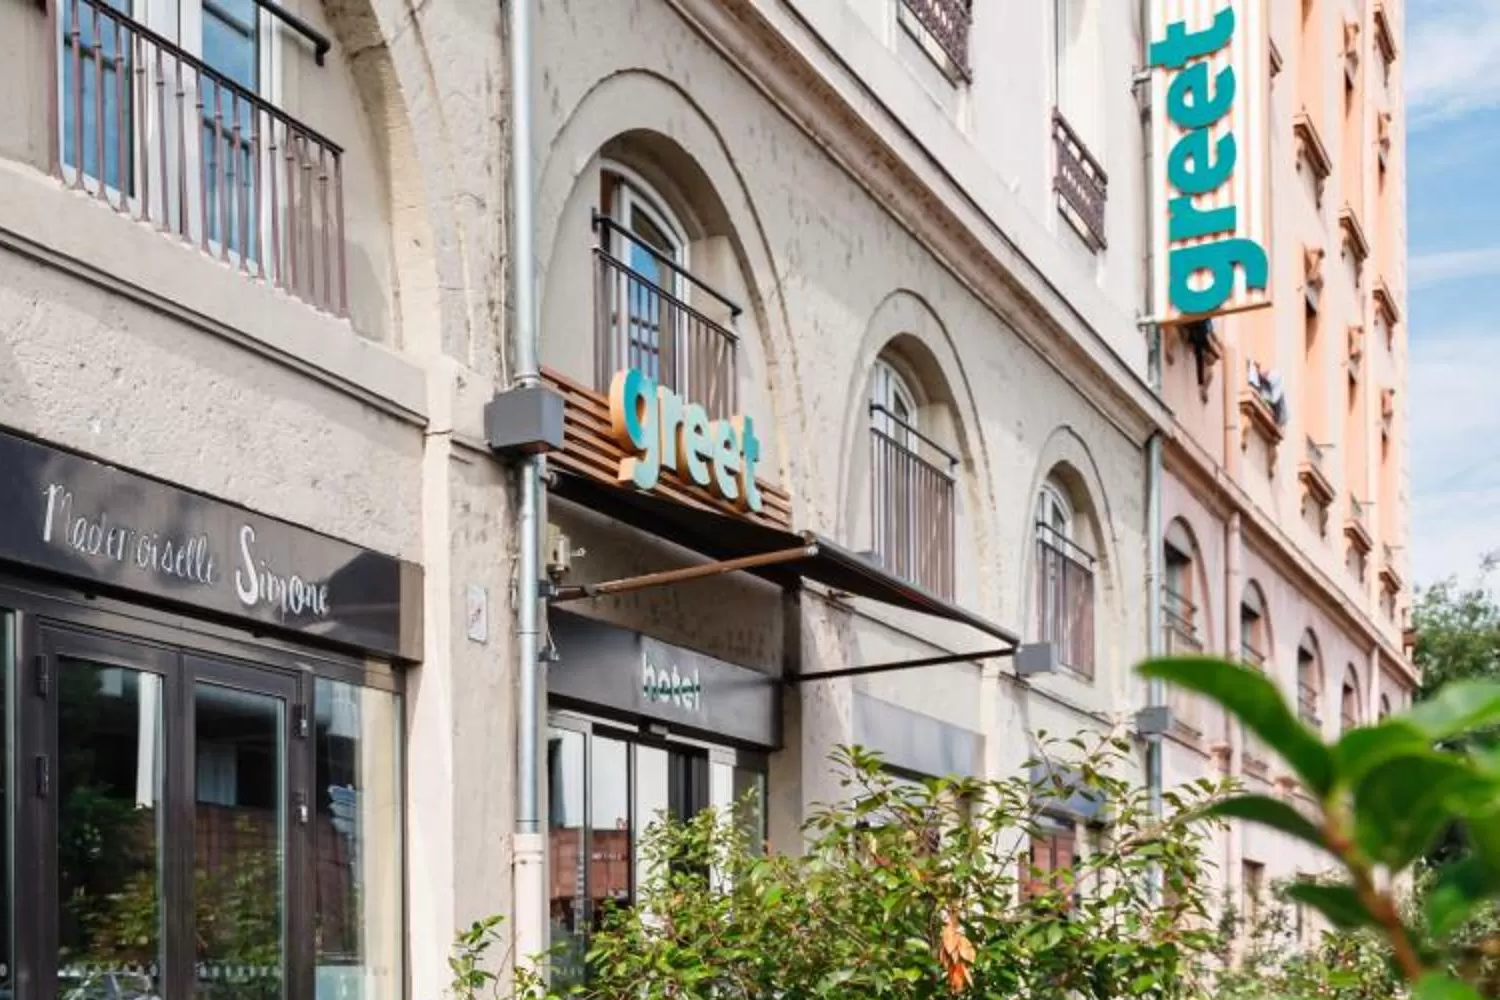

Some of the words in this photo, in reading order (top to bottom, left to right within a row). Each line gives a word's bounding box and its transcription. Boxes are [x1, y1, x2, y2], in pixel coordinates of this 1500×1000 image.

[1150, 6, 1269, 314] greet
[612, 368, 763, 513] greet
[236, 525, 330, 618] Simone
[643, 651, 701, 711] hotel
